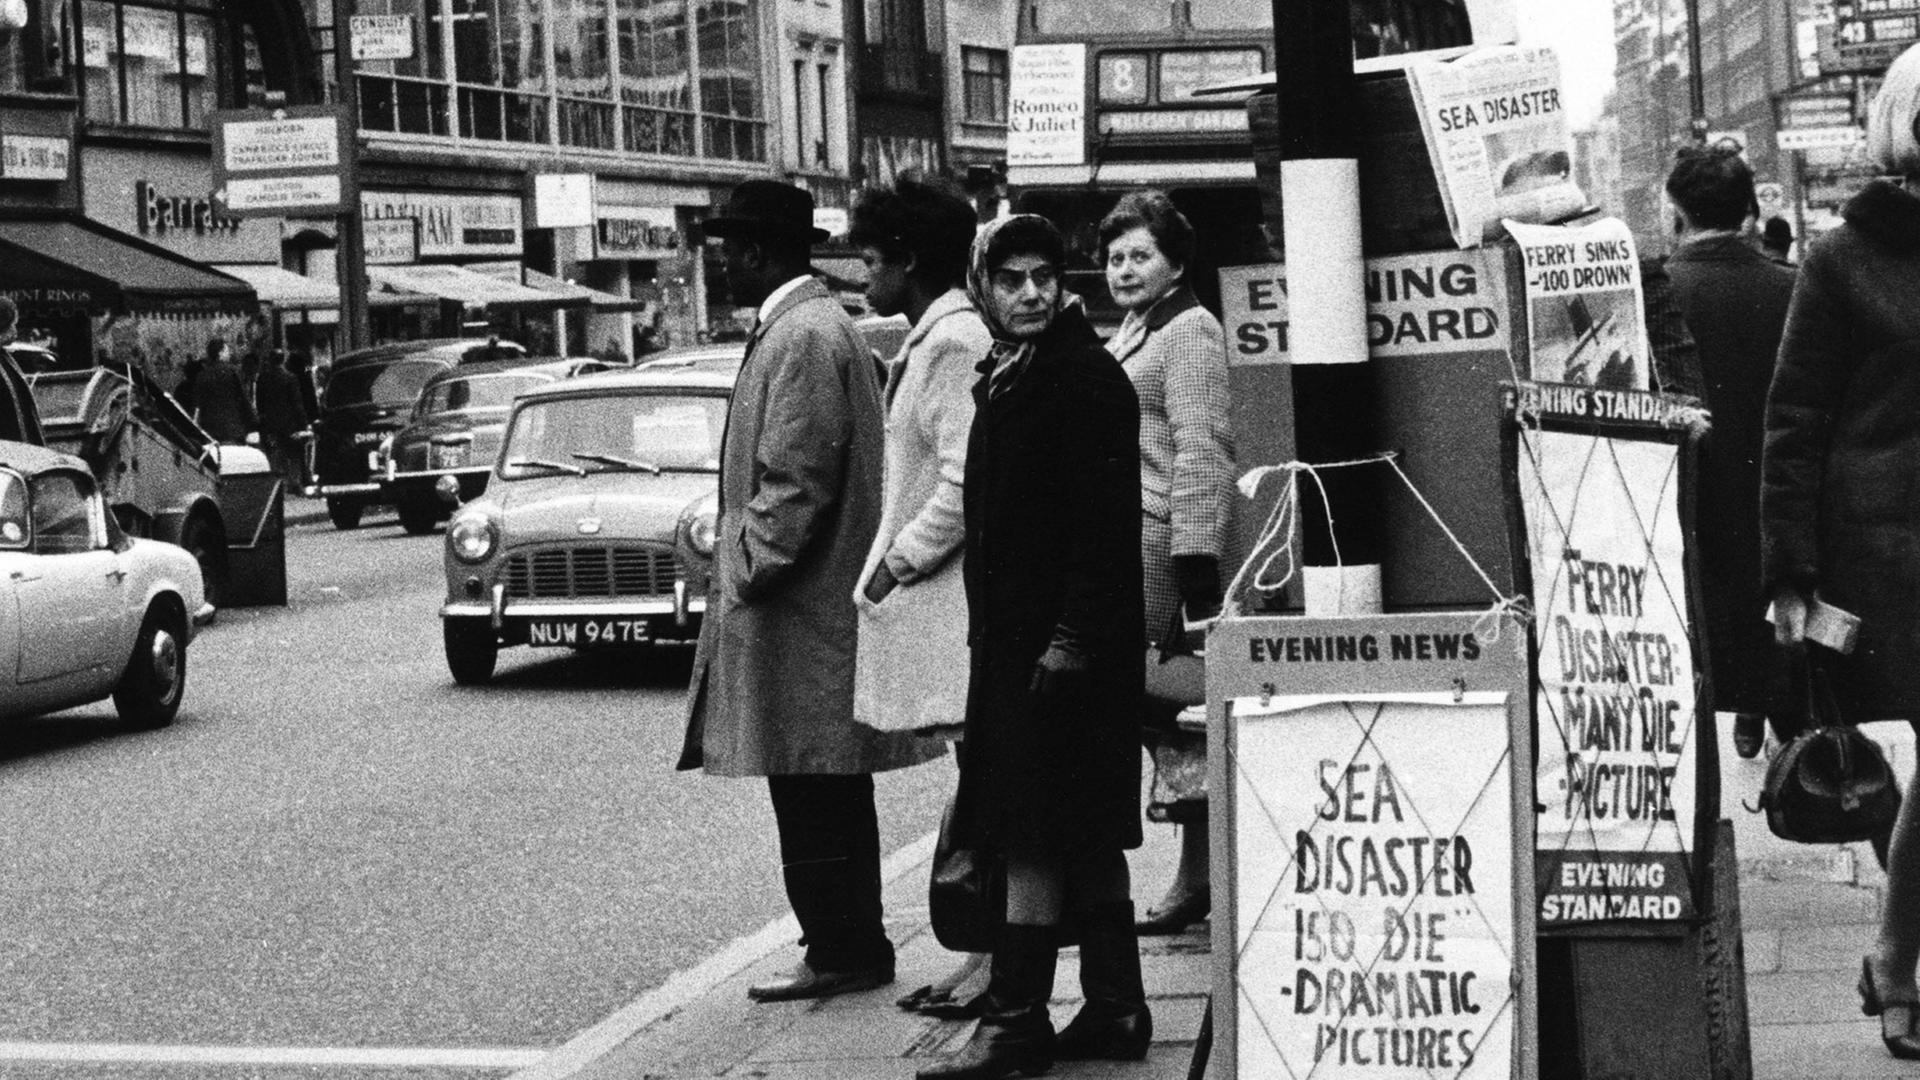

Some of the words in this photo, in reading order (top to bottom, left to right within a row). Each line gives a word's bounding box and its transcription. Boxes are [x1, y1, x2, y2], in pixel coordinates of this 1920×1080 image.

[1113, 59, 1134, 92] 8
[1013, 98, 1078, 114] Romeo
[1026, 116, 1077, 132] Juliet
[1438, 105, 1479, 132] SEA
[1483, 88, 1561, 123] DISASTER
[137, 179, 240, 235] Barra
[1525, 243, 1575, 267] FERRY
[1585, 240, 1630, 262] SINKS
[1237, 307, 1499, 354] STDARD
[1563, 550, 1643, 617] FERRY
[530, 622, 577, 643] NUW
[585, 621, 649, 642] 947E
[1250, 634, 1379, 661] EVENING
[1390, 633, 1481, 660] NEWS
[1561, 685, 1634, 753] MANY
[1639, 686, 1681, 754] DIE
[1315, 759, 1404, 822] SEA
[1295, 830, 1475, 897] DISASTER
[1561, 862, 1665, 888] EVENING
[1542, 895, 1681, 920] STANDARD
[1314, 1022, 1474, 1069] PICTURES
